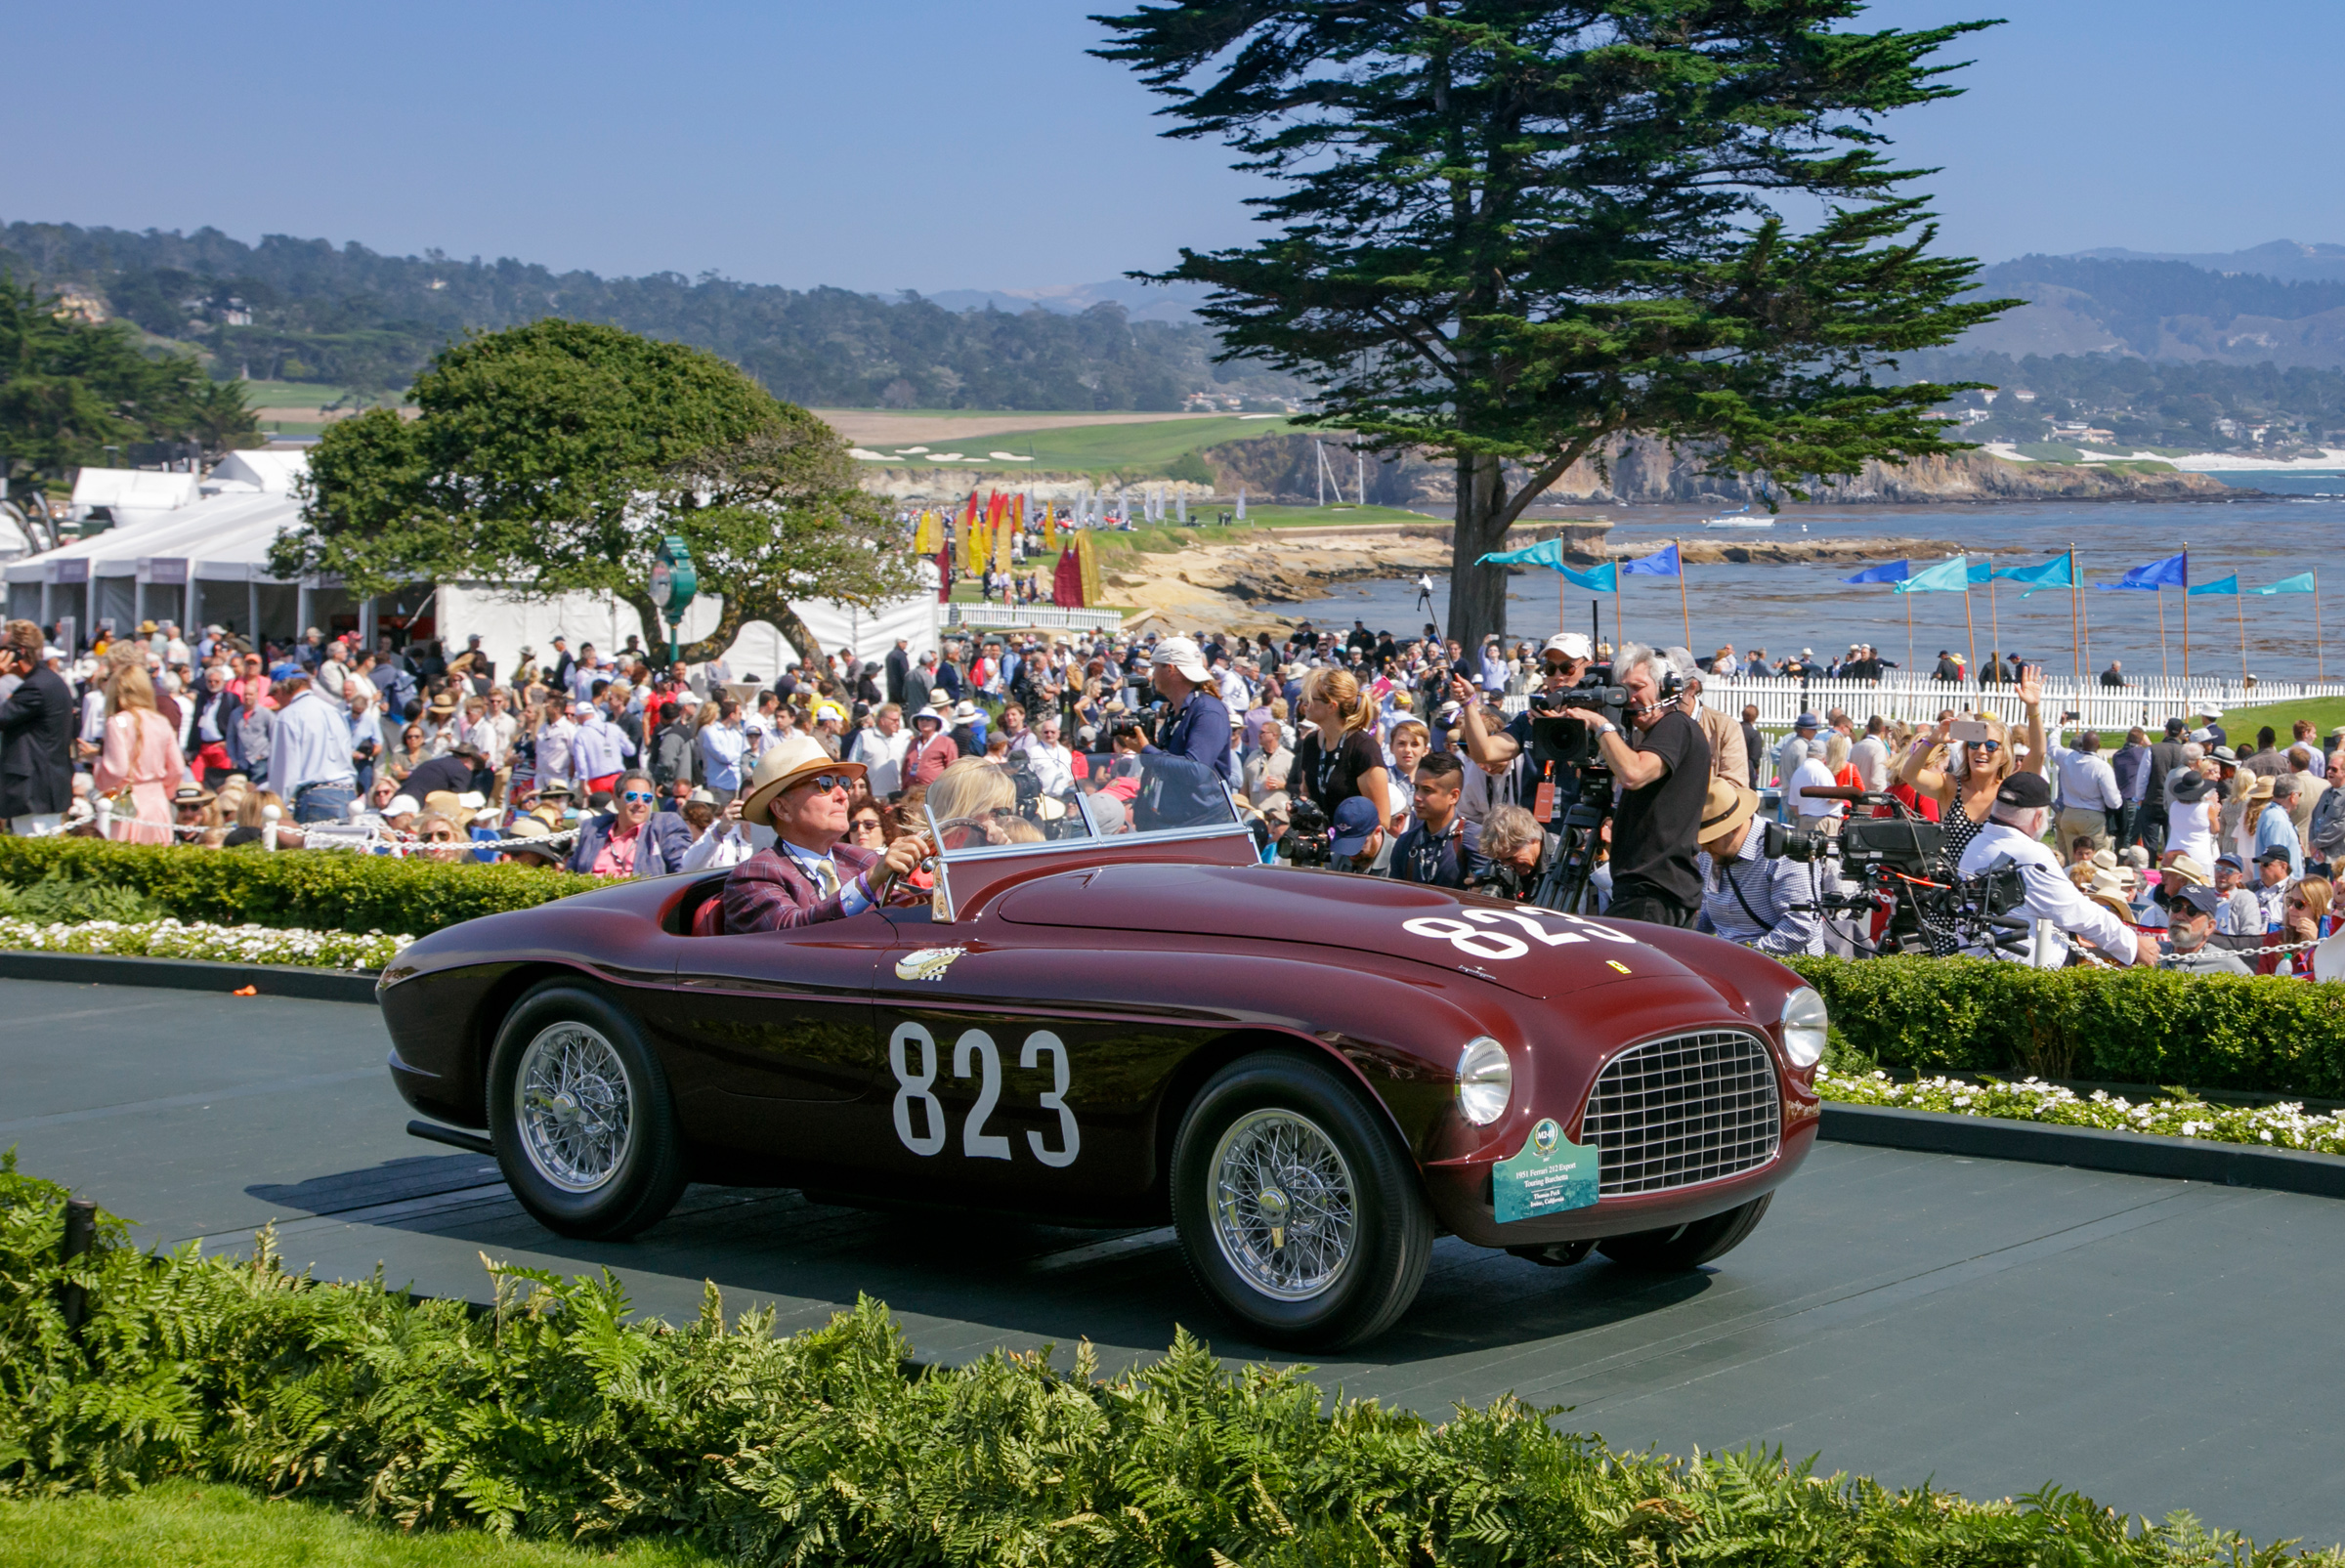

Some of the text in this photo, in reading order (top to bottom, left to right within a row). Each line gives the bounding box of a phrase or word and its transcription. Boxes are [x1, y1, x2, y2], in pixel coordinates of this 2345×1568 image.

[1402, 906, 1637, 959] 823
[889, 1021, 1081, 1168] 823
[1515, 1163, 1576, 1179] 1951 Ferrari 212 Export
[1524, 1174, 1568, 1188] Touring Barchetta
[1544, 1196, 1564, 1205] California
